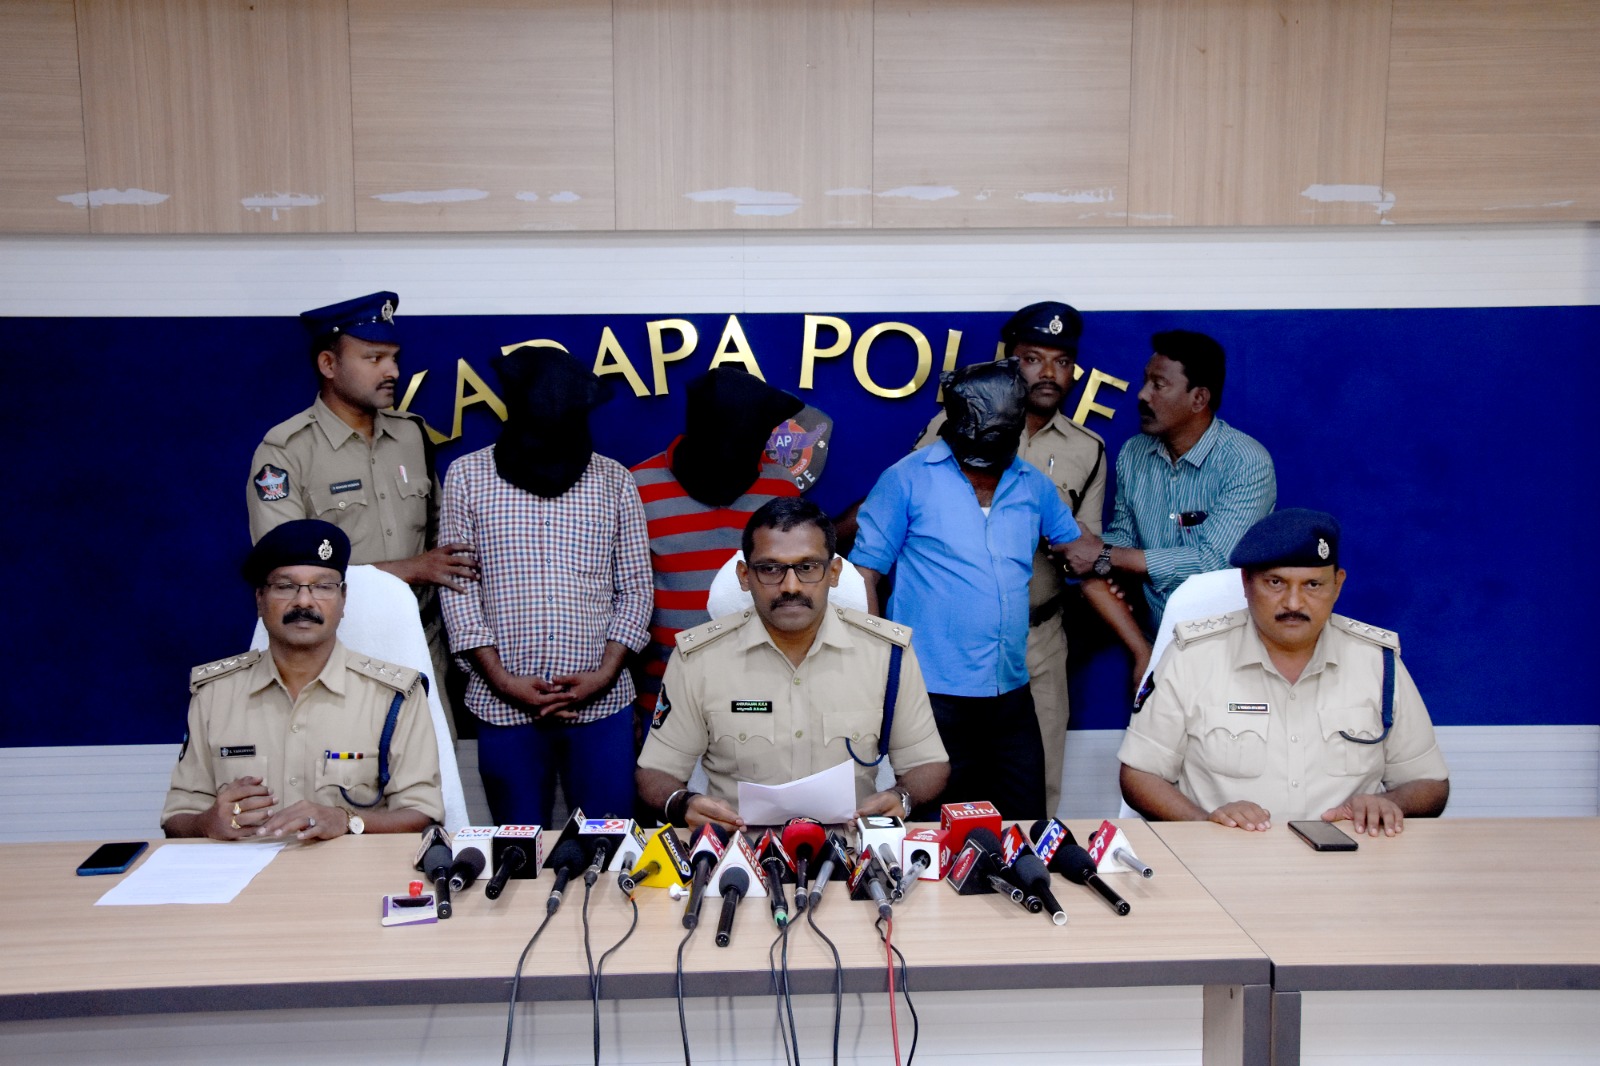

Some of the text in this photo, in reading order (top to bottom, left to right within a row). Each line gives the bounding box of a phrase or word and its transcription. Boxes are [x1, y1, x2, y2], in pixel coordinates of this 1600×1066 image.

[391, 314, 1130, 445] AAPA POE
[775, 435, 792, 447] AP
[951, 808, 994, 817] hmtv
